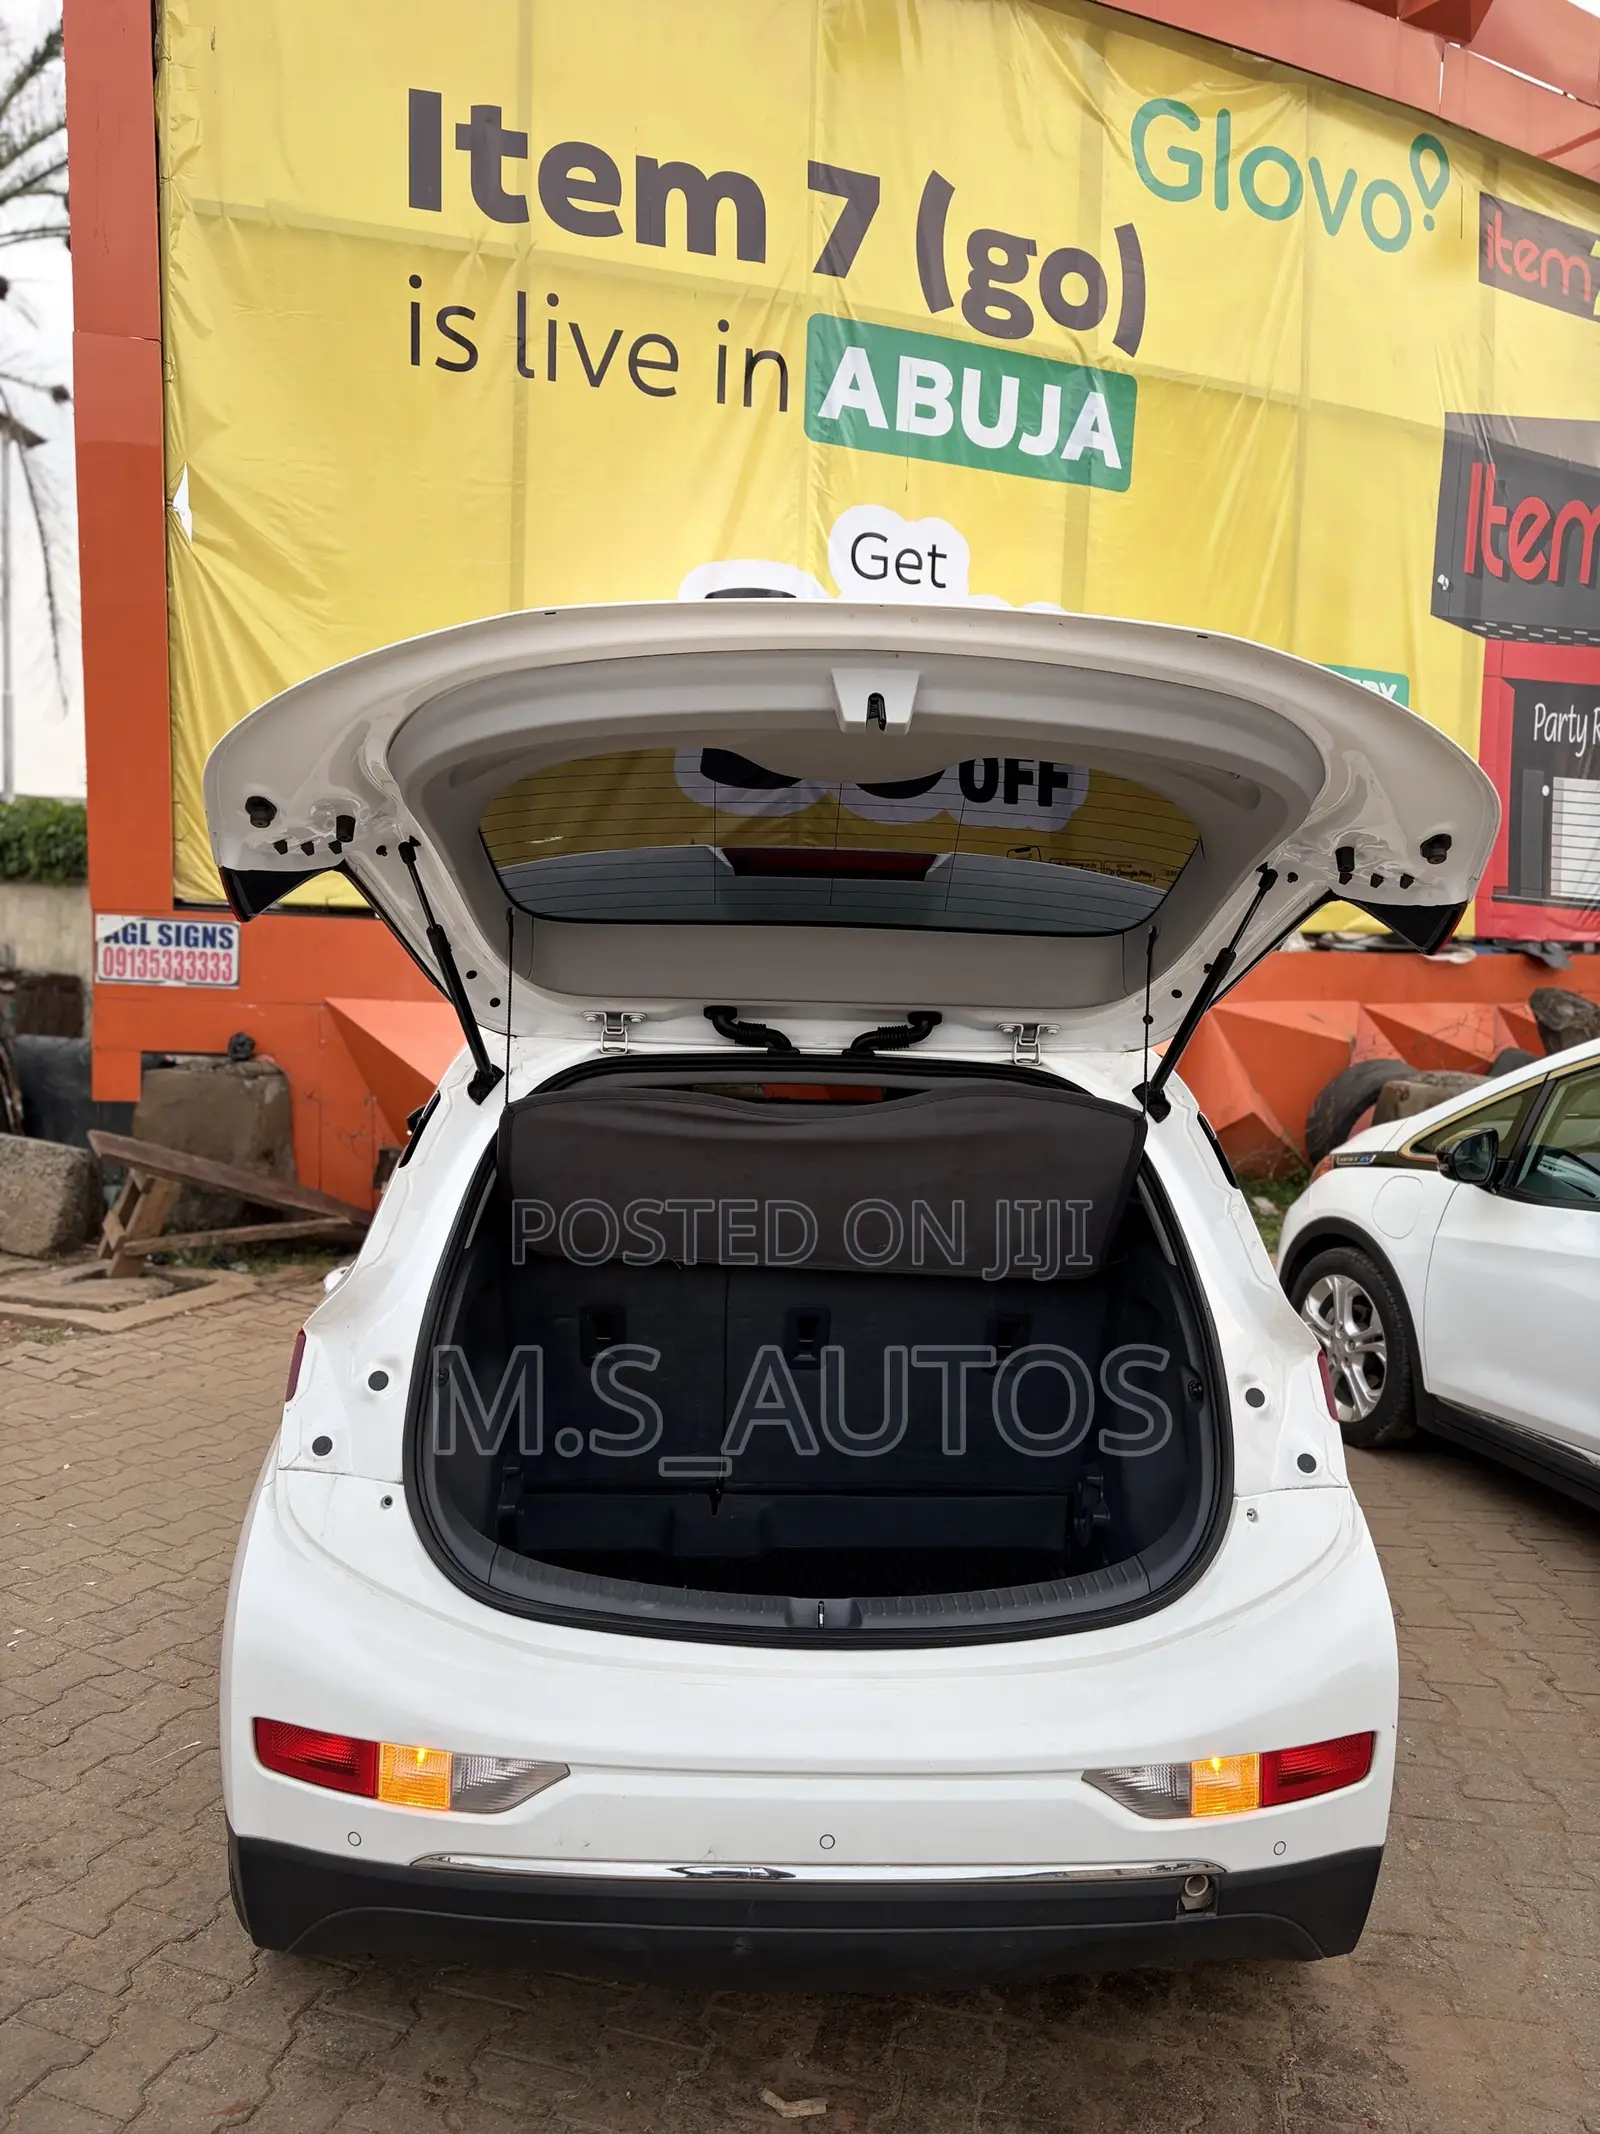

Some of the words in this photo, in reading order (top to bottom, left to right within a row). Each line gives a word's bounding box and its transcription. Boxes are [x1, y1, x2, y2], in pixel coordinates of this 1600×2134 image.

[408, 88, 767, 264] Item
[808, 160, 881, 278] 7
[915, 169, 1146, 358] (go)
[1487, 211, 1600, 316] item
[410, 274, 479, 373] is
[516, 290, 680, 398] live
[717, 319, 789, 413] in
[818, 346, 1122, 470] ABUJA
[851, 531, 947, 589] Get
[1533, 703, 1588, 757] Party
[959, 758, 1069, 807] OFF
[102, 946, 232, 982] 09135333333
[157, 923, 233, 949] SIGNS
